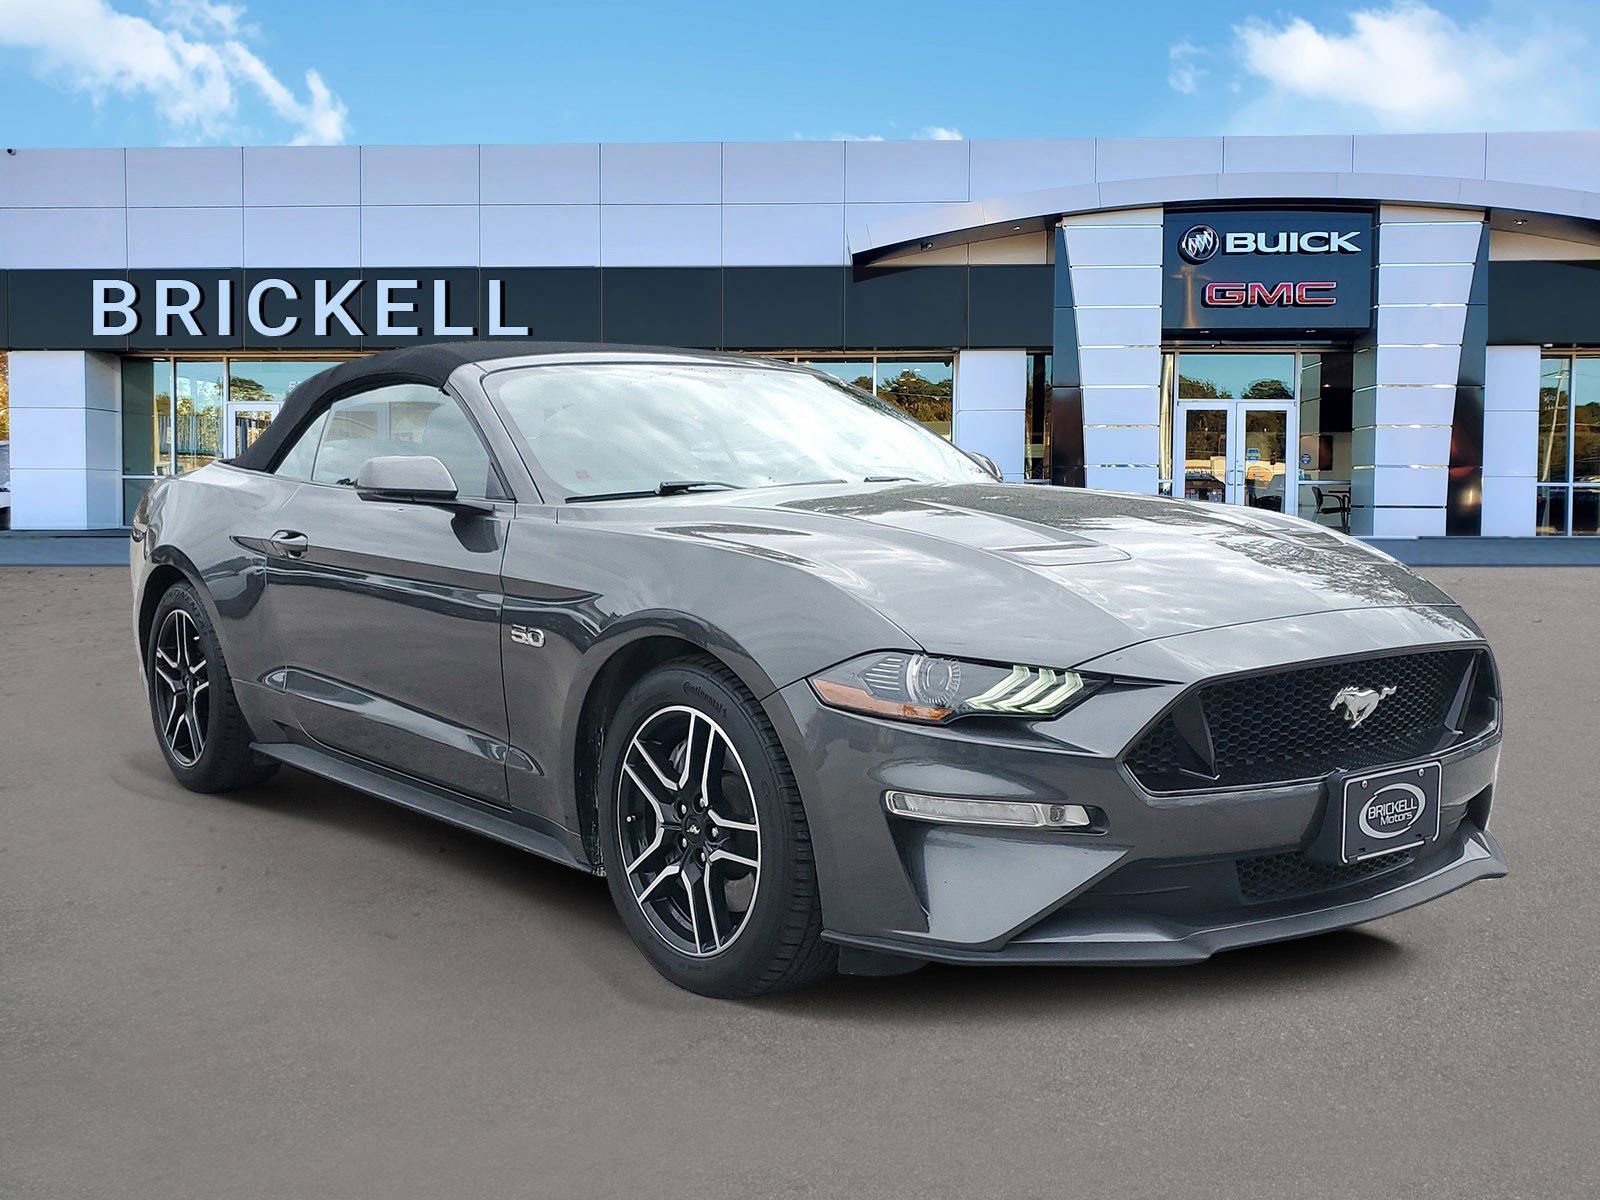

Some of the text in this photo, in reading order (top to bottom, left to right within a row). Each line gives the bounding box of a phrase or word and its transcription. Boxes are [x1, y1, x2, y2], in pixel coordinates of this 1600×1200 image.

[1226, 231, 1361, 253] BUICK
[1206, 281, 1336, 305] GMC
[91, 278, 531, 337] BRICKELL
[1368, 797, 1418, 820] BRICKELL
[1380, 811, 1413, 826] Motors
